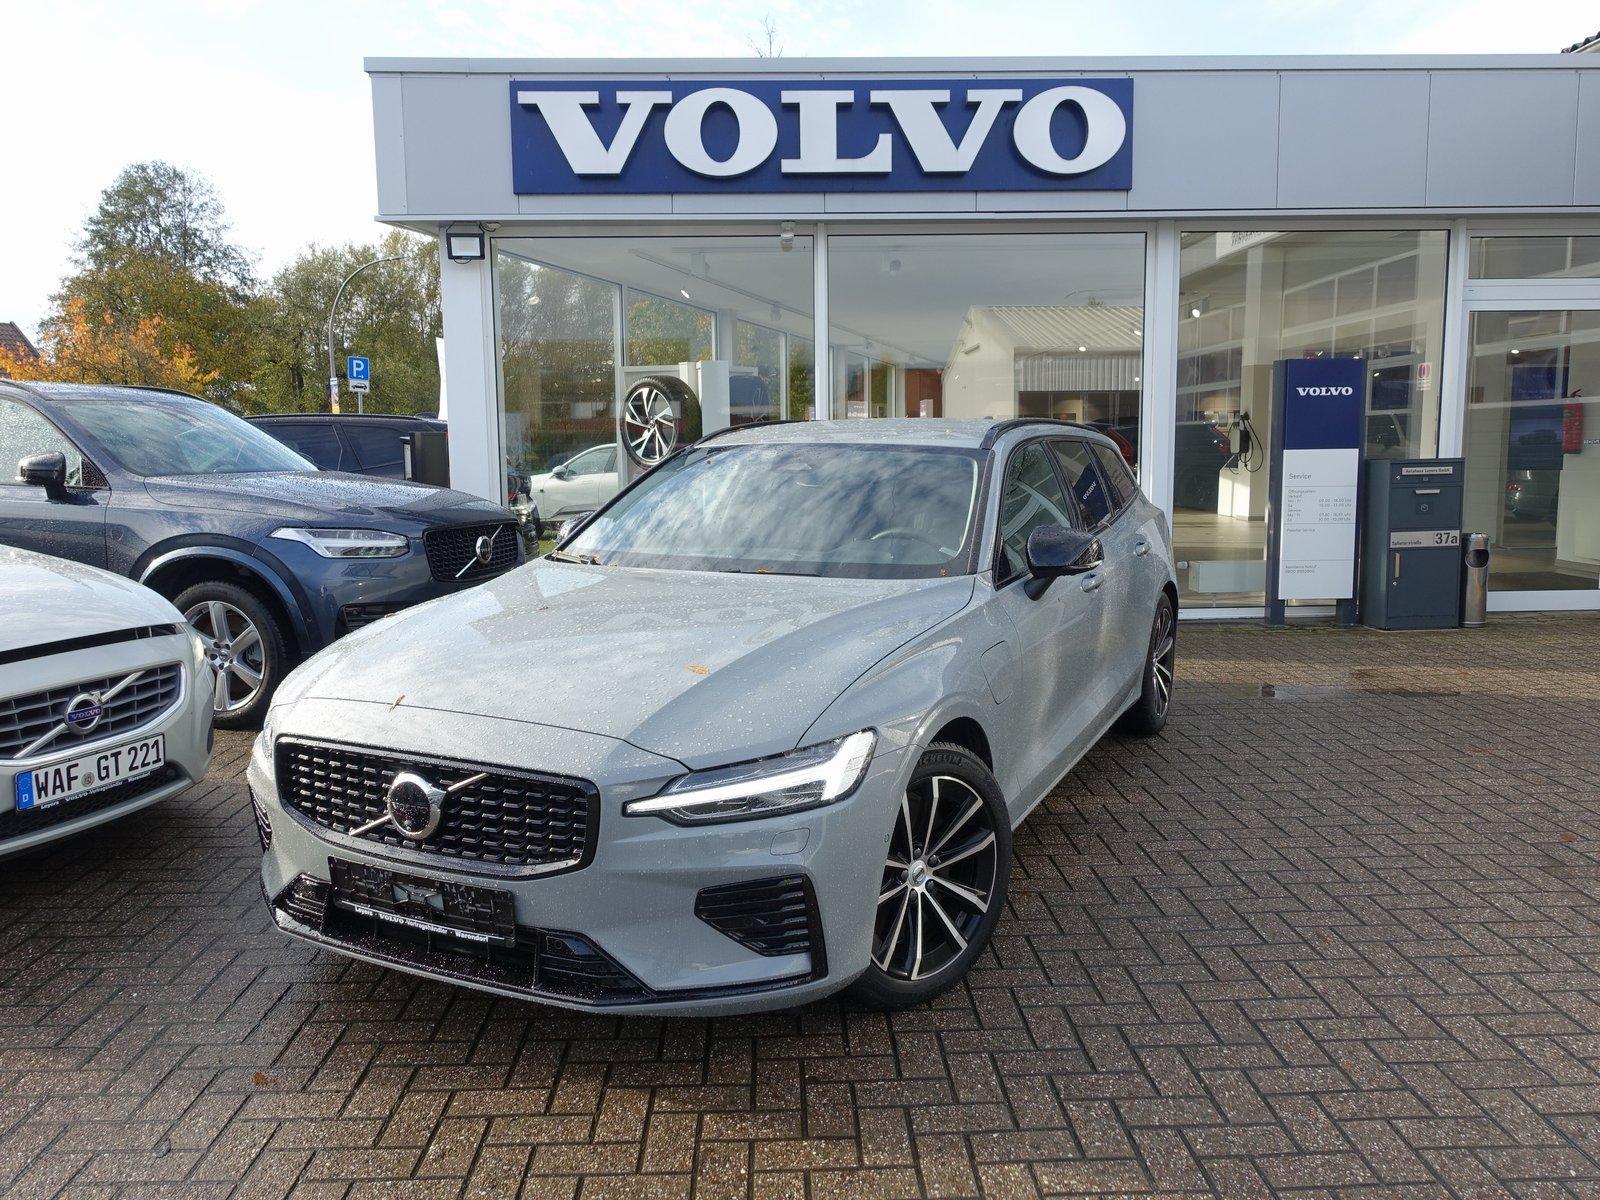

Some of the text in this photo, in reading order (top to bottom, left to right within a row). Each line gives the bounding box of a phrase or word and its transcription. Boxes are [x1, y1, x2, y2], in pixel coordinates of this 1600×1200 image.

[517, 85, 1127, 177] VOLVO
[353, 359, 364, 377] P
[1296, 386, 1353, 396] VOLVO
[1288, 472, 1312, 481] Service
[1435, 532, 1458, 545] 37a
[71, 707, 101, 720] VOLVO
[22, 739, 162, 803] D WAF GT 221
[455, 931, 489, 943] Warendorf
